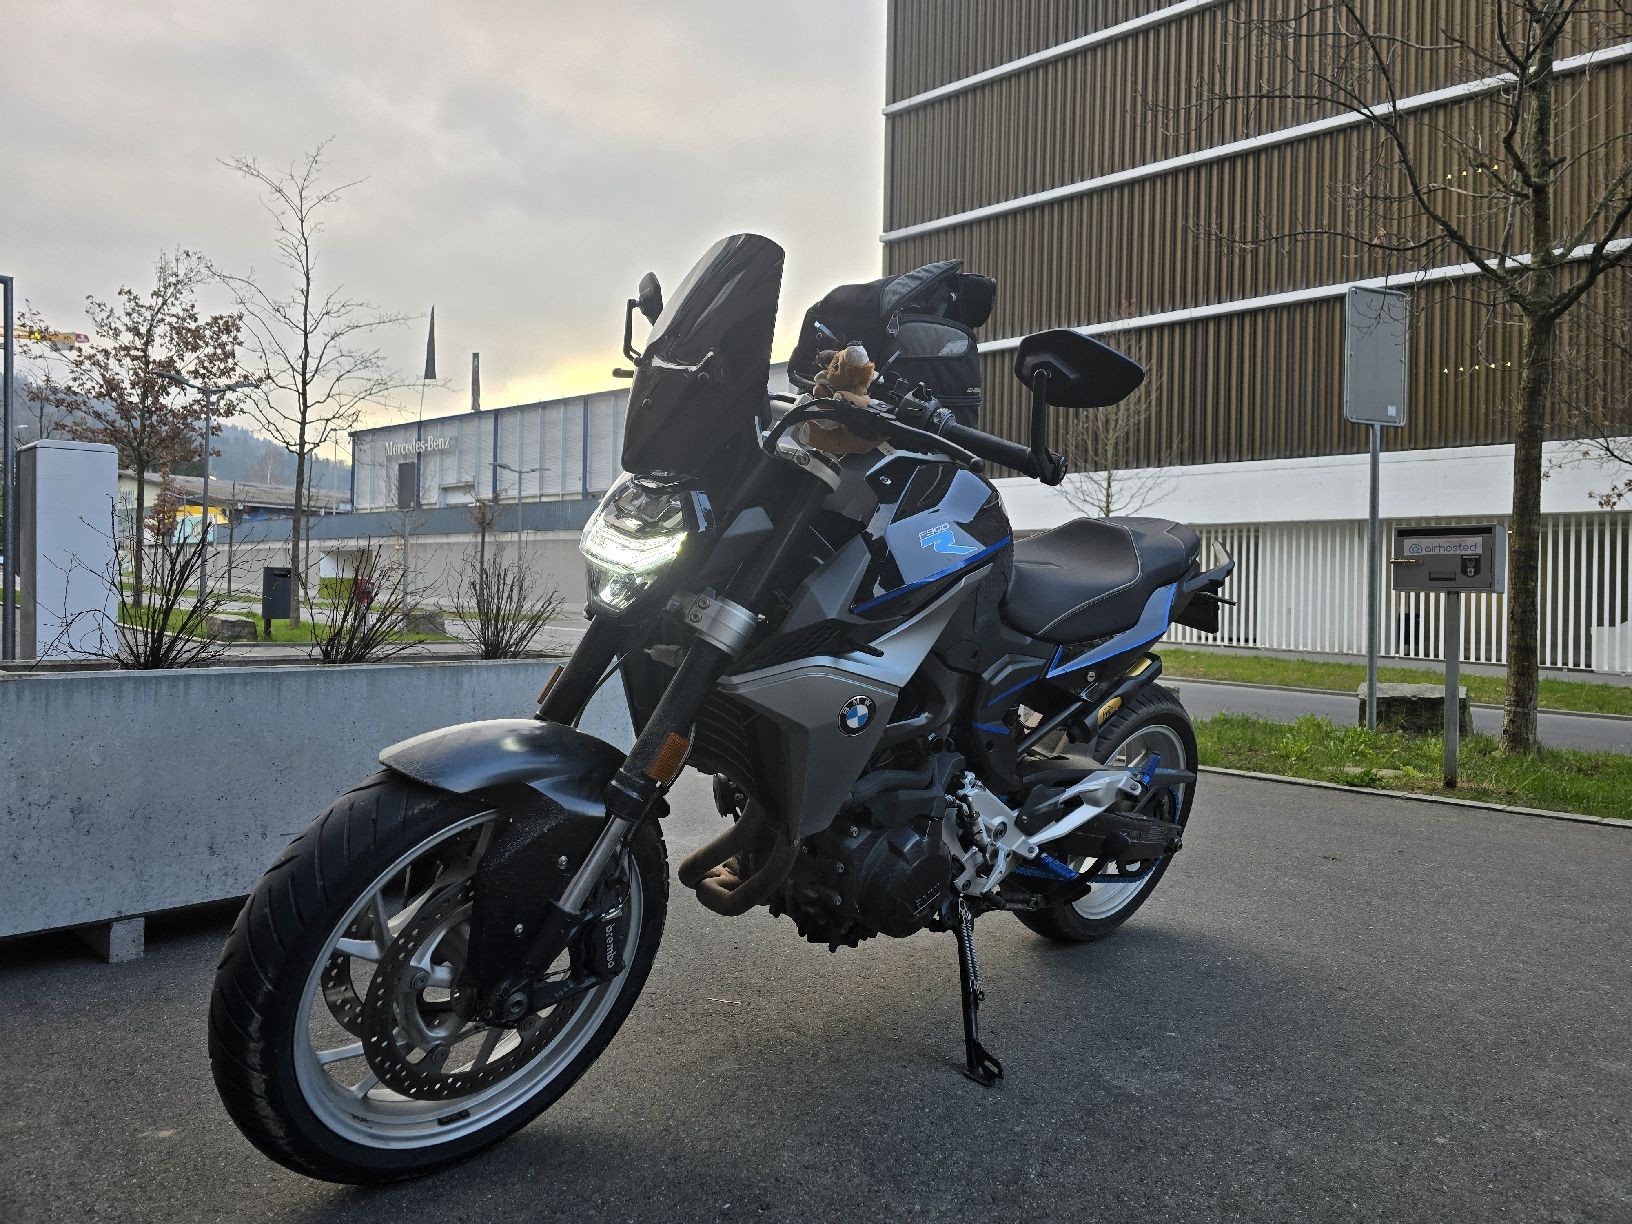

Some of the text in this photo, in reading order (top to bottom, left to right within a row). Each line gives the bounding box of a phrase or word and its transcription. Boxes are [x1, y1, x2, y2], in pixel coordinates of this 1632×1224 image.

[386, 436, 450, 456] Mercedes-Benz
[1424, 543, 1477, 553] airhosted
[841, 697, 873, 715] BMW
[605, 923, 617, 969] brembo
